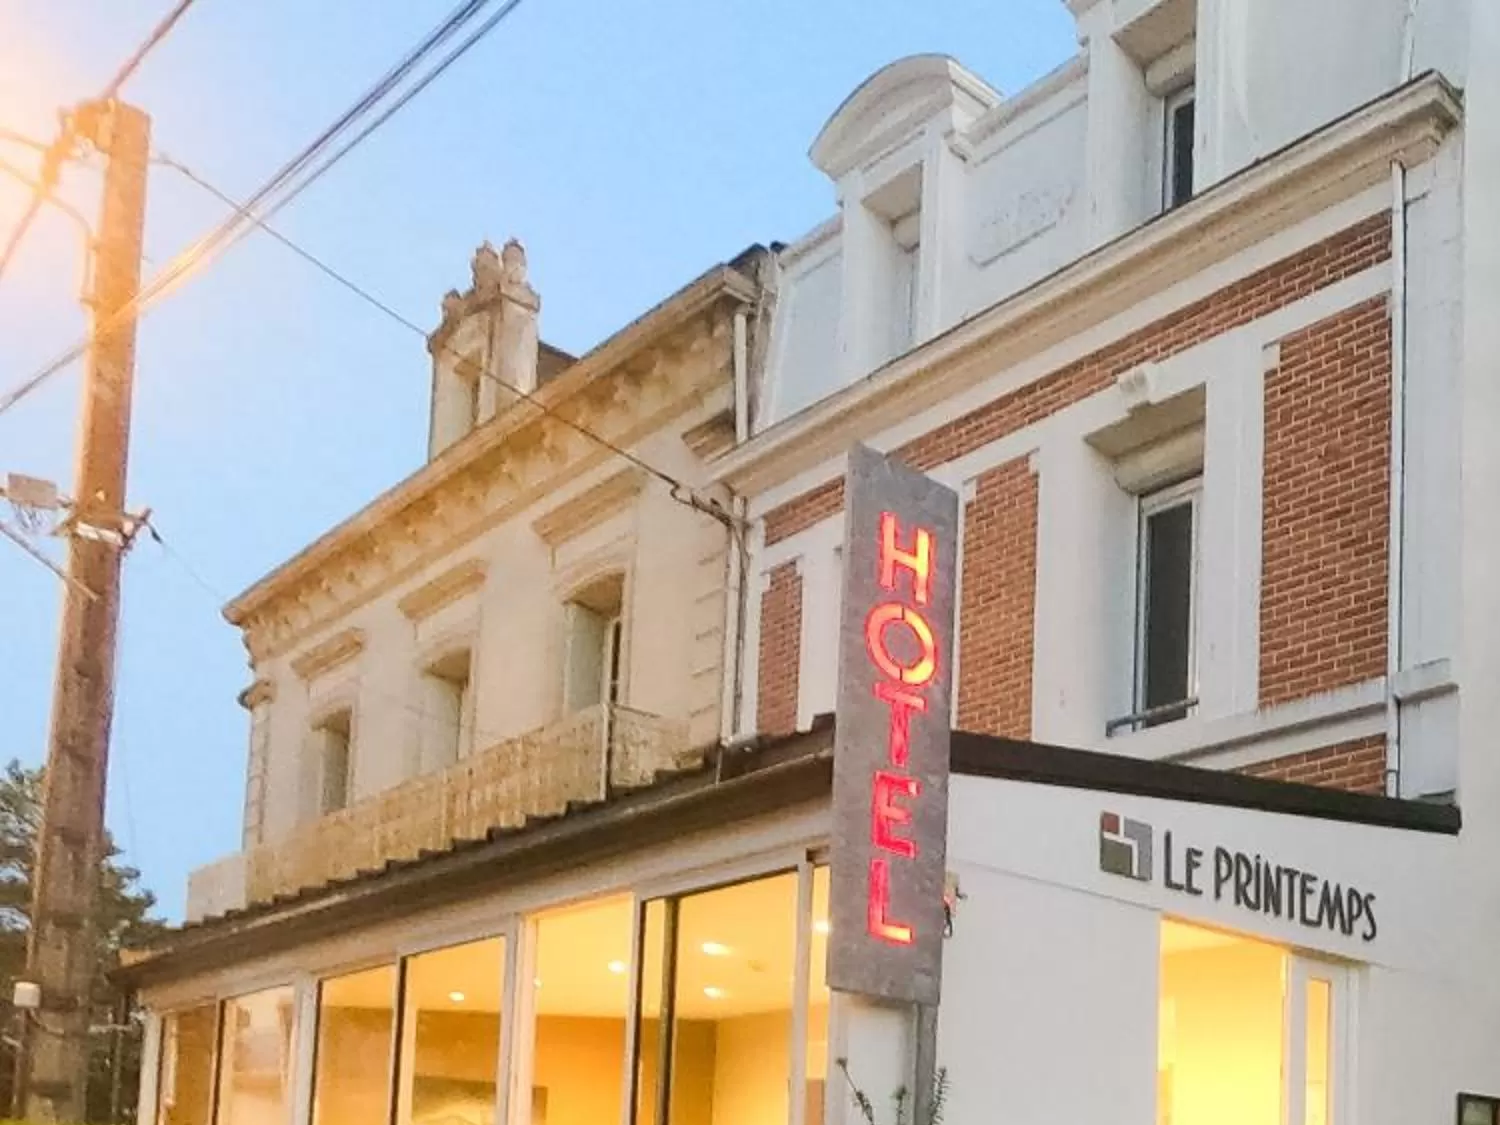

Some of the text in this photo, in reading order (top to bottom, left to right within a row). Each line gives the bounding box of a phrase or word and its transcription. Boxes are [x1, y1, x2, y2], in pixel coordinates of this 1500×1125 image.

[865, 511, 938, 944] HOTEL
[1164, 830, 1378, 942] LE PRINTEMPS
